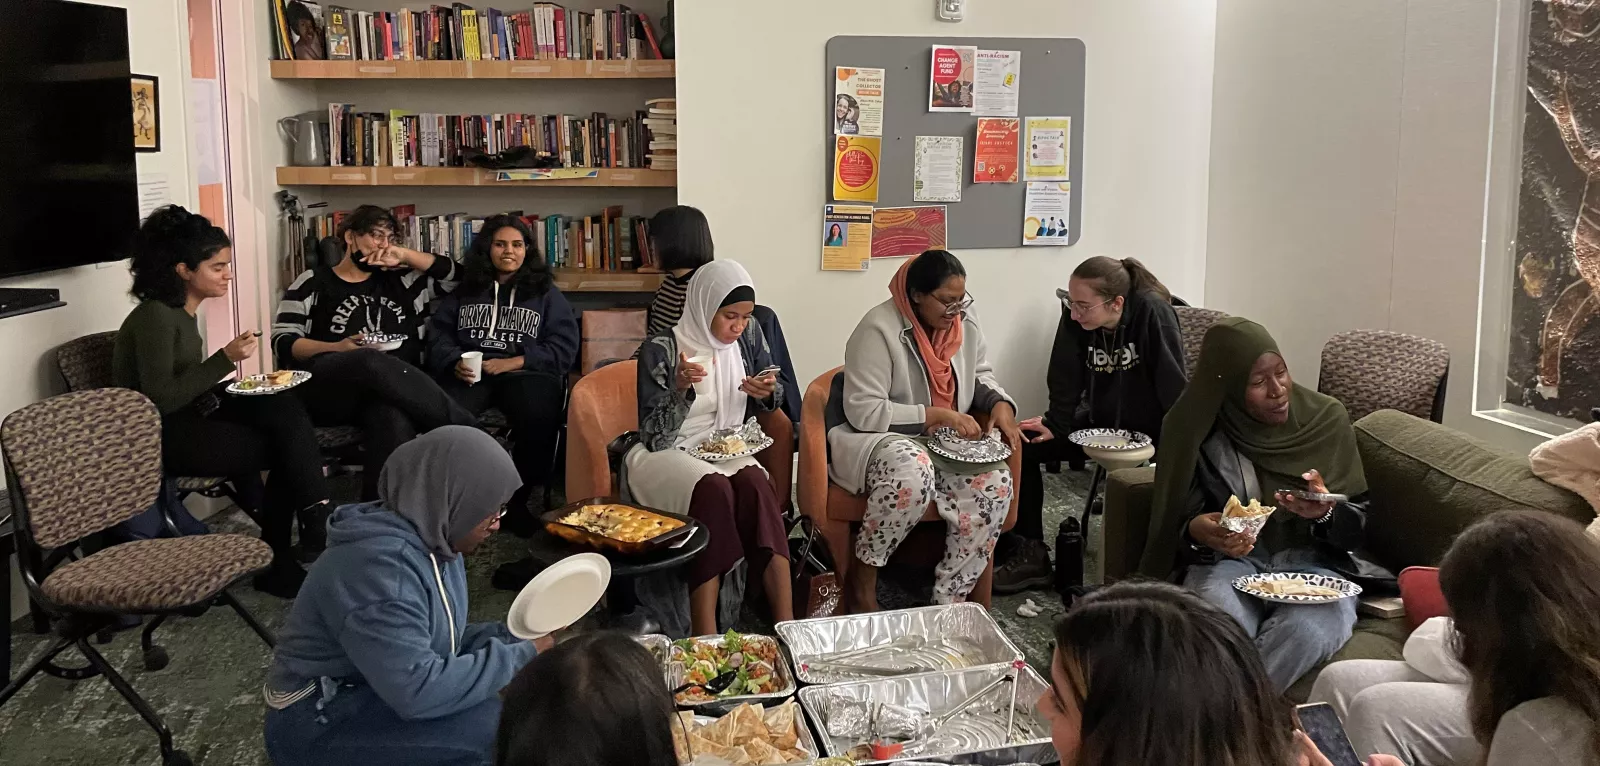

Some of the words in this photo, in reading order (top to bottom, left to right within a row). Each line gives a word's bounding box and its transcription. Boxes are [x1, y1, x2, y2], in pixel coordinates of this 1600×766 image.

[329, 295, 360, 334] CREEP
[380, 296, 406, 324] REAL
[458, 304, 494, 330] BRYN
[497, 306, 541, 339] MAWR
